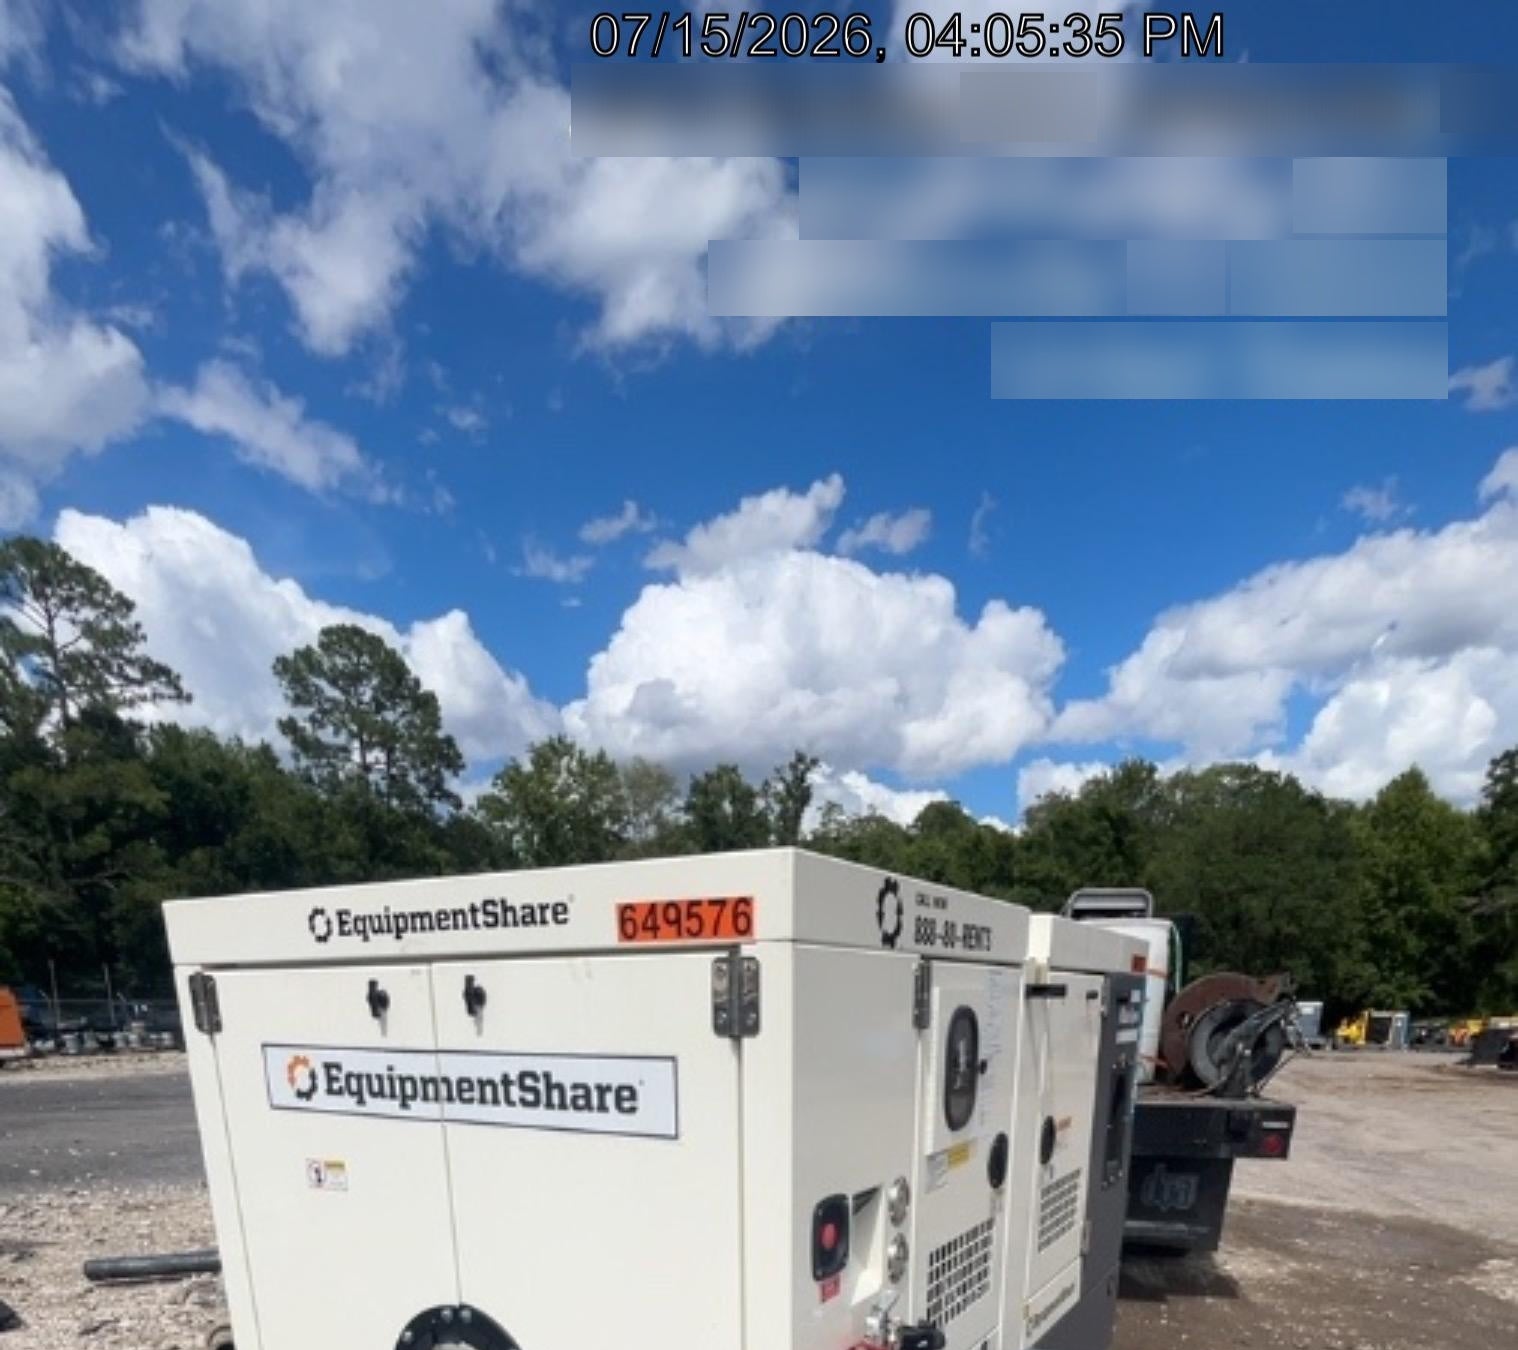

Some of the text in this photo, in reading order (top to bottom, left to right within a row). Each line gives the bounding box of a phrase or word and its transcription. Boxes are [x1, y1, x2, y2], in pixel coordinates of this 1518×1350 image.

[336, 898, 569, 941] EquipmentShare
[618, 898, 753, 940] 649576
[322, 1061, 639, 1114] EquipmentShare
